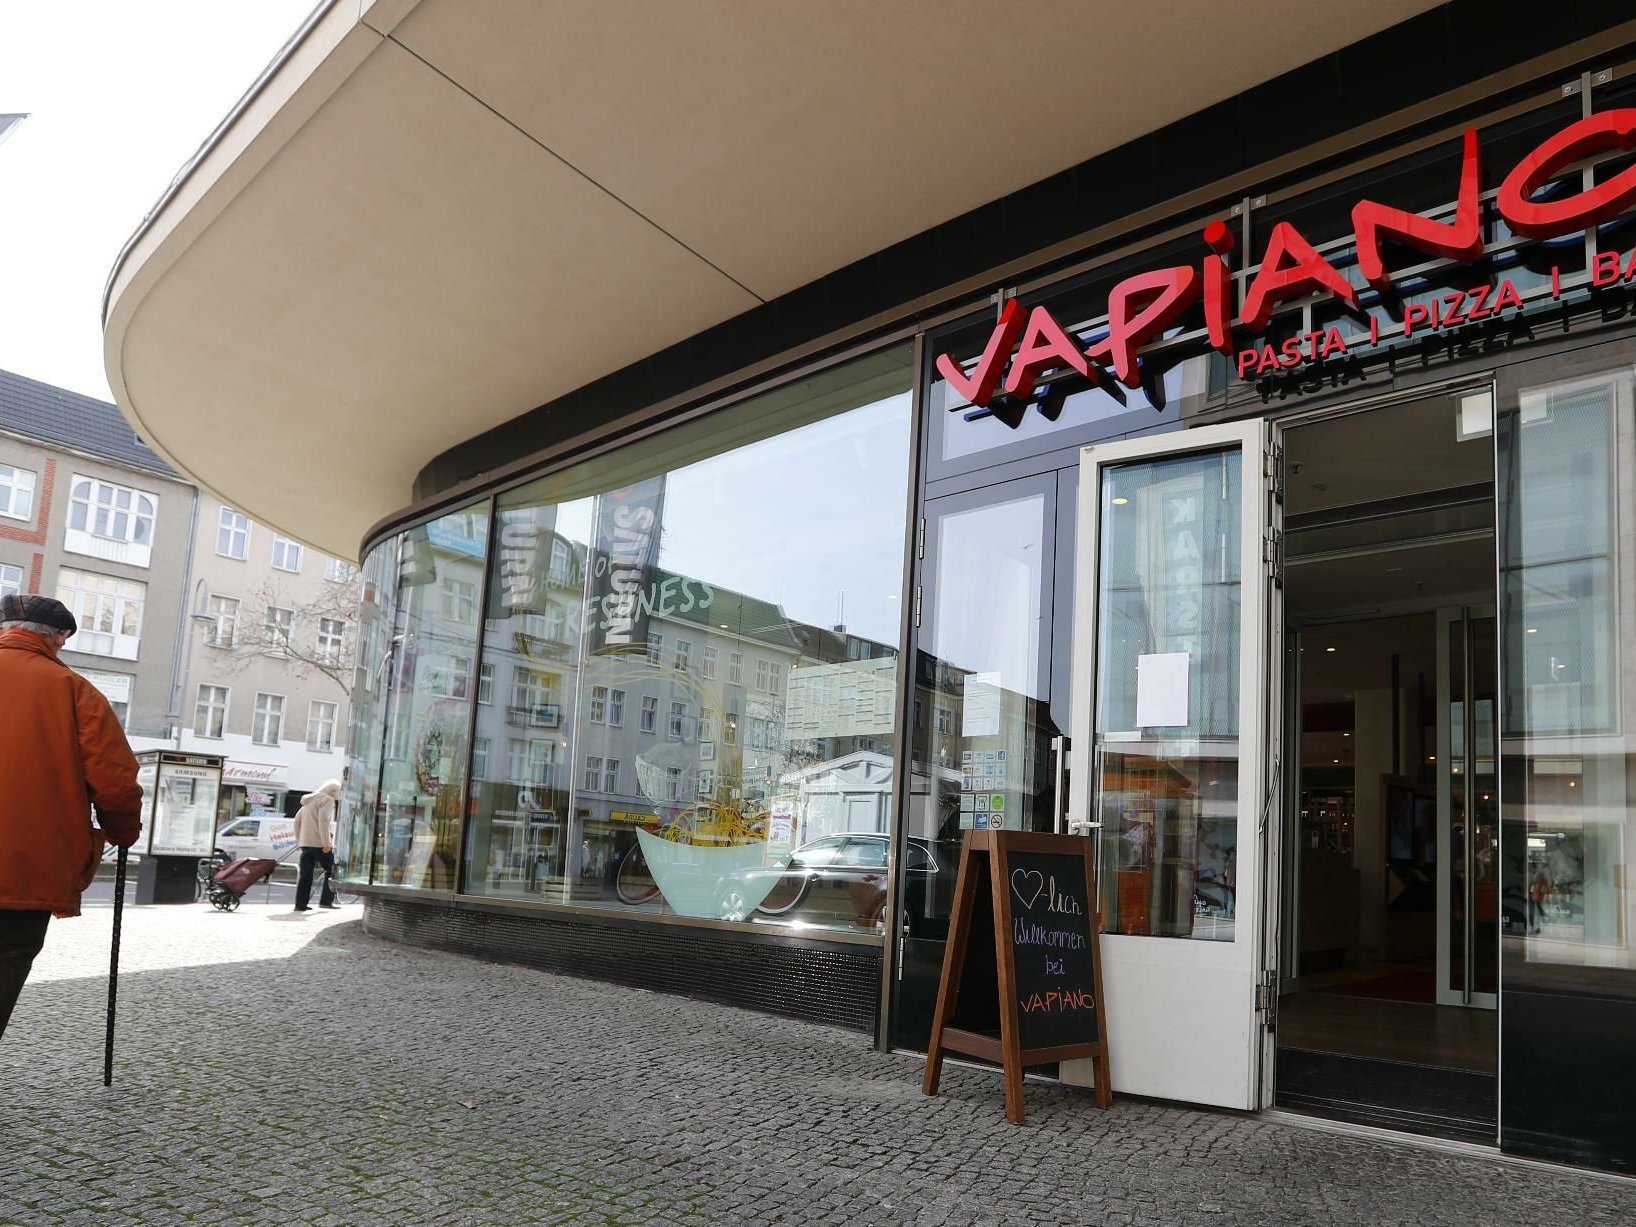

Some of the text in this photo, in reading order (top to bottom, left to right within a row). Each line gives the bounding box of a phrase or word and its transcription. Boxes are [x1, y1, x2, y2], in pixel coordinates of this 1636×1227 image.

[1239, 327, 1347, 379] PASTA
[1405, 278, 1524, 338] PIZZA
[1015, 917, 1086, 950] Willkommen
[1046, 955, 1066, 975] bei
